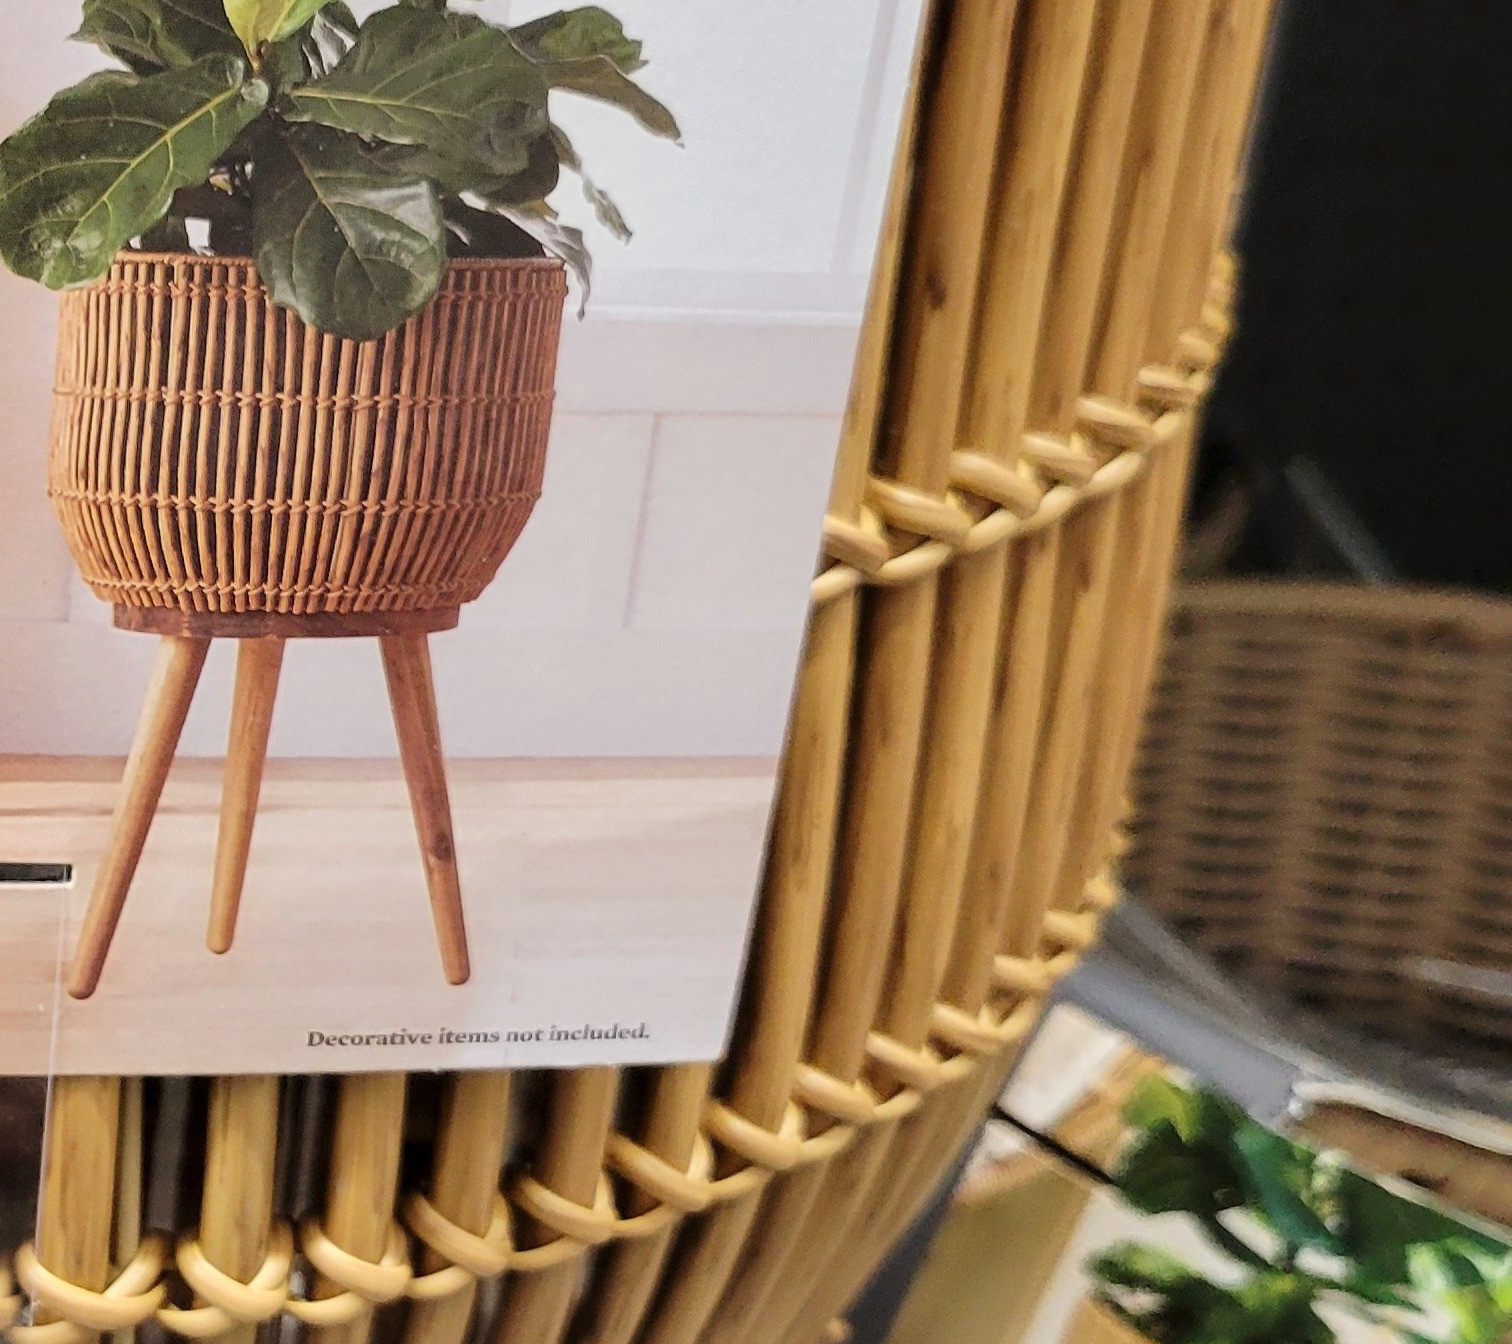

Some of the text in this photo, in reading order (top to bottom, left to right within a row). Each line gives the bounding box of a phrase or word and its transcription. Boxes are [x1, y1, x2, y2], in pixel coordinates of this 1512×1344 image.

[306, 1022, 650, 1048] Decorative items not included.
